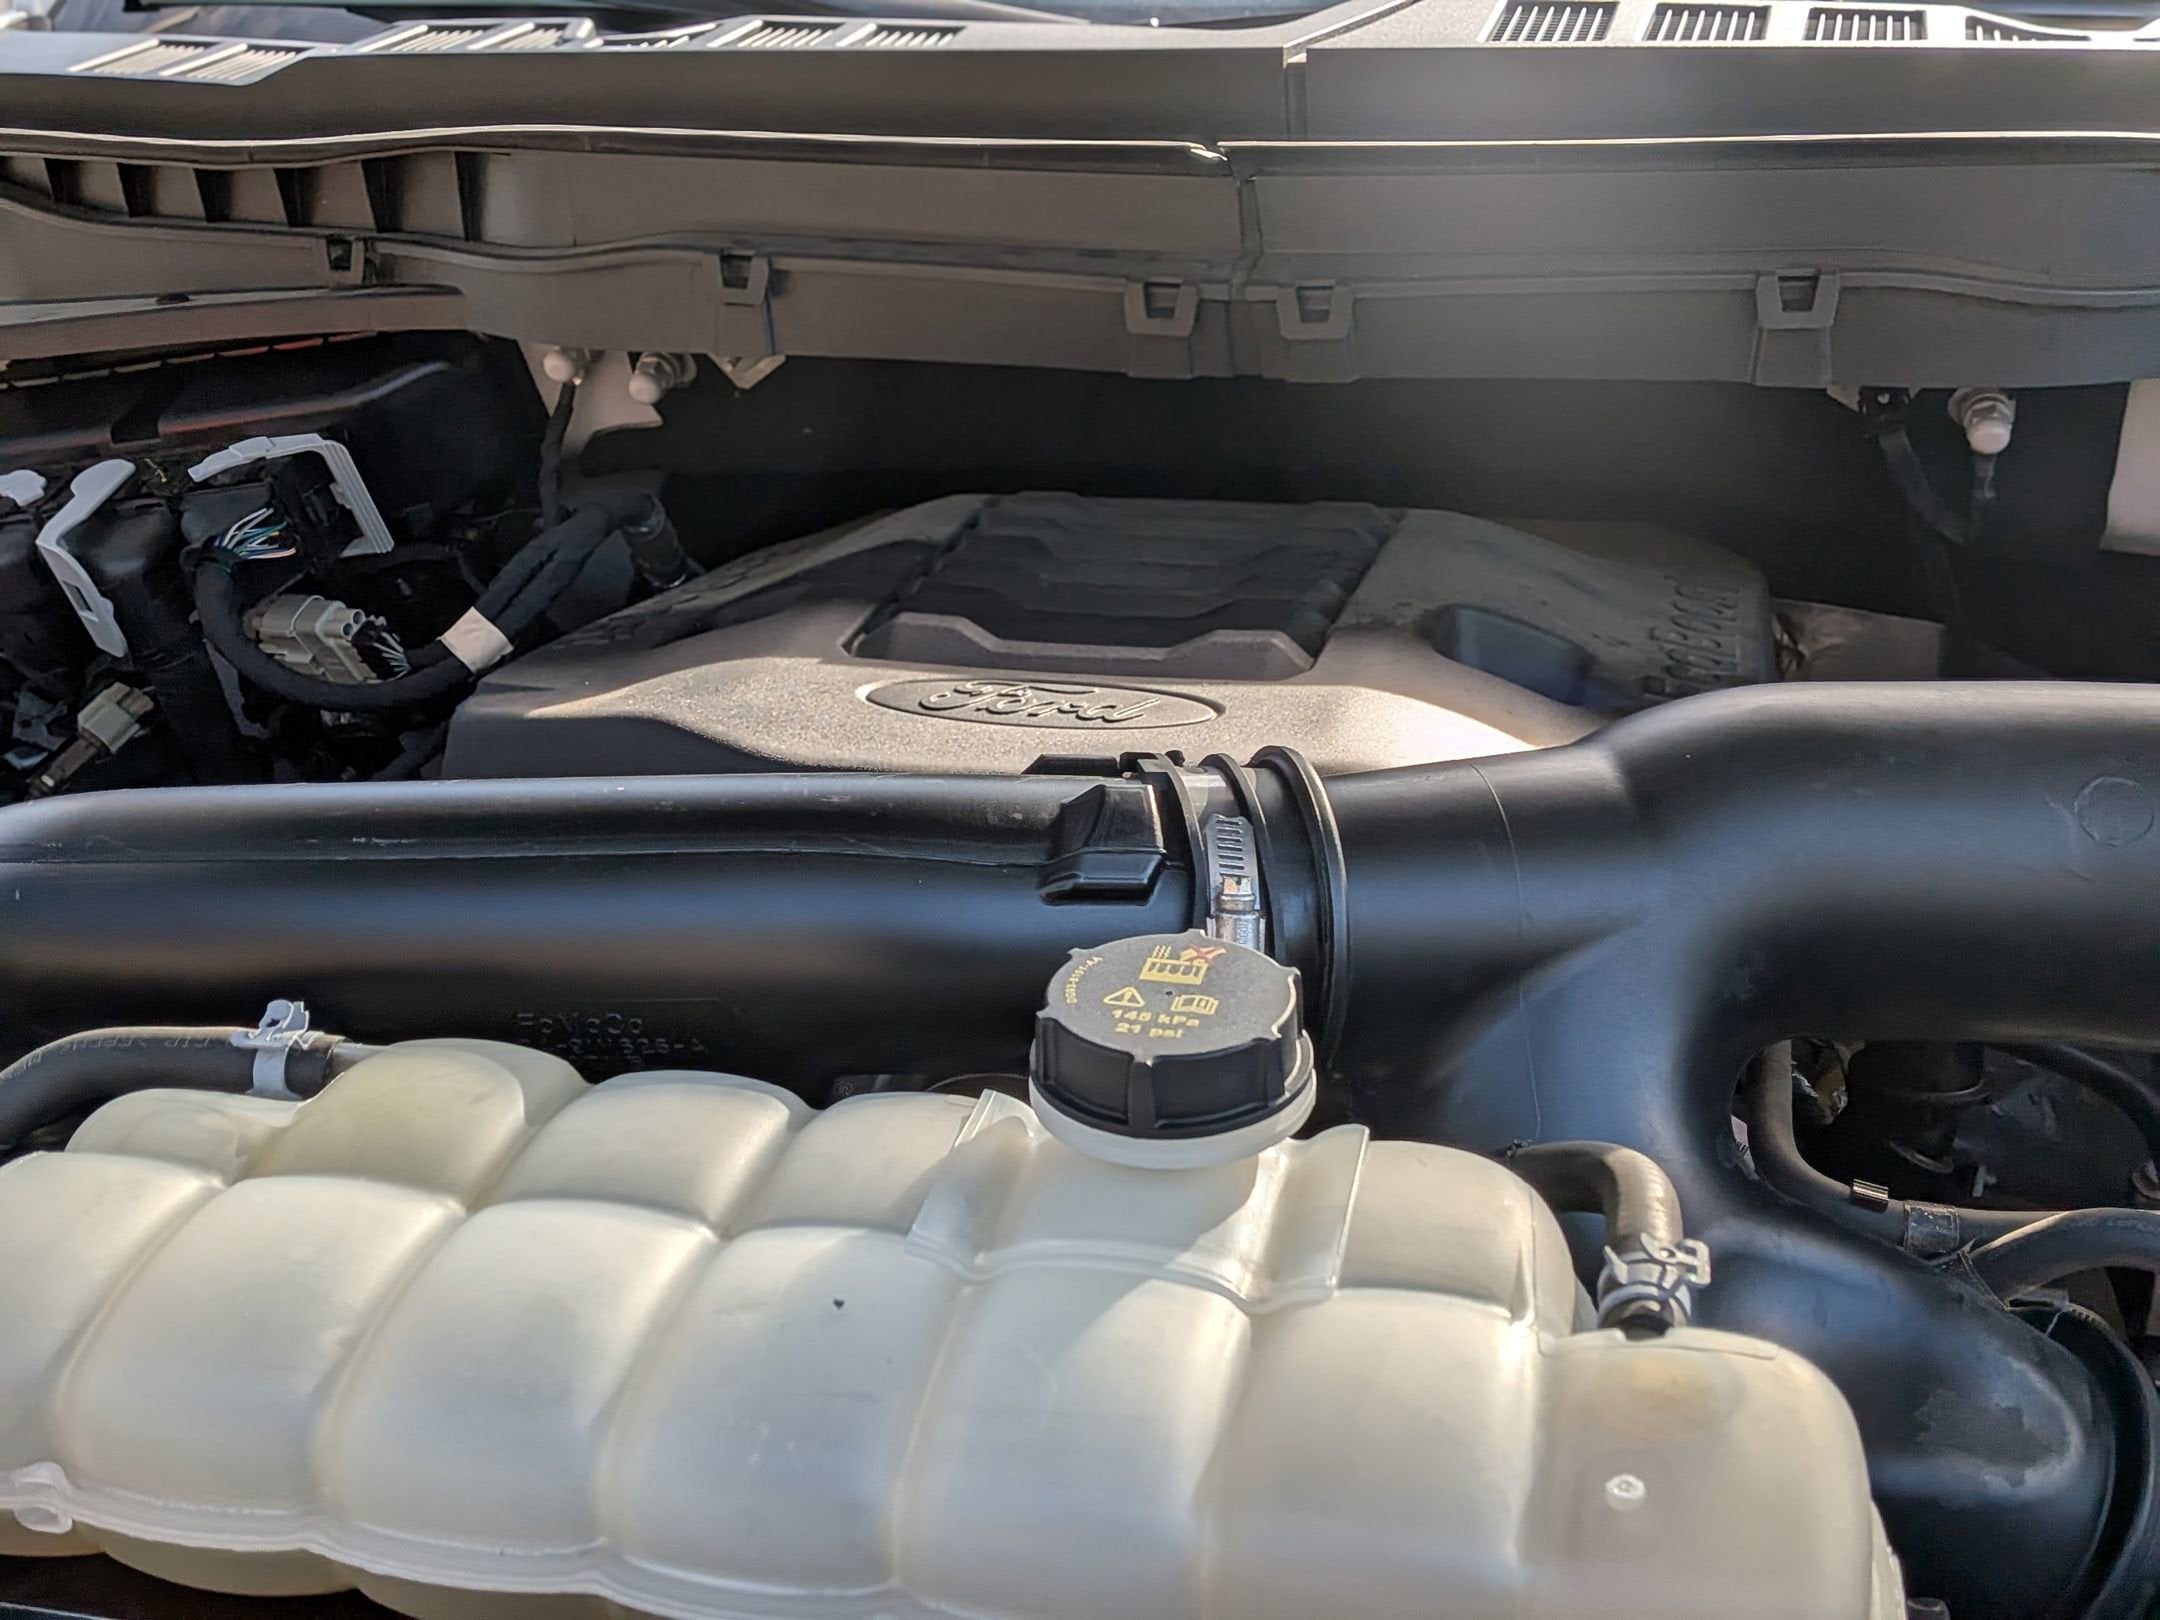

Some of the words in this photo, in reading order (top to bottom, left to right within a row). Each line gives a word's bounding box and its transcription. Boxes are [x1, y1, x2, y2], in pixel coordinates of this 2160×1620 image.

[919, 680, 1160, 723] Ford
[1157, 1013, 1200, 1027] kPa
[1114, 1022, 1142, 1034] 21
[1148, 1027, 1184, 1039] psi
